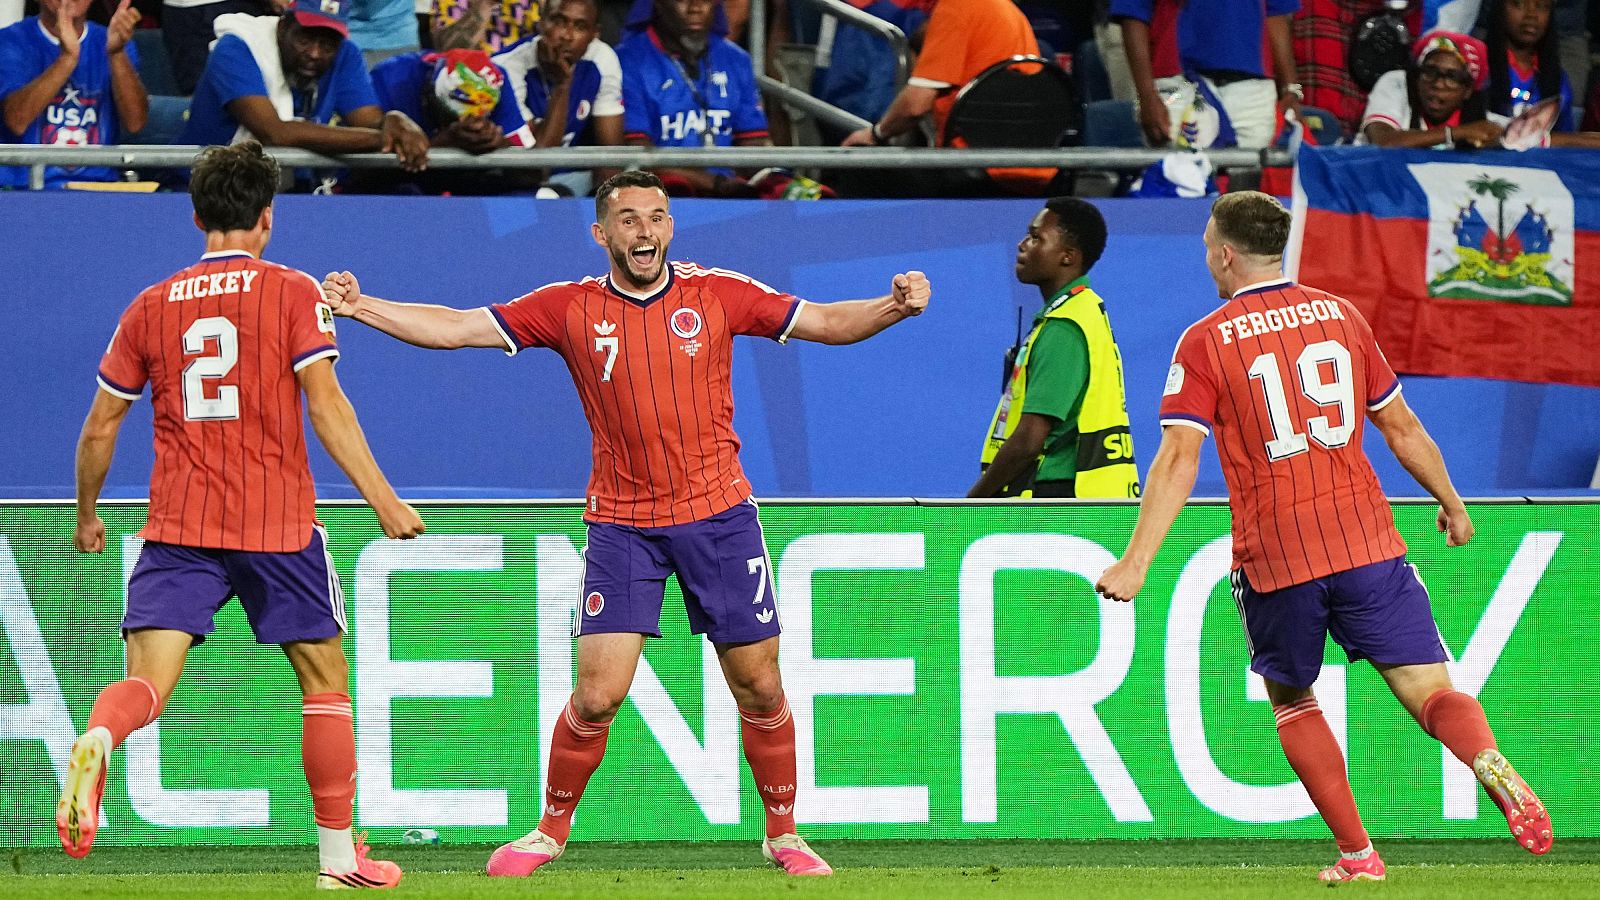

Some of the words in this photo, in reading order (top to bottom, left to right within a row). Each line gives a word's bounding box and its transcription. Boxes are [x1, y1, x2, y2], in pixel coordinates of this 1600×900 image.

[46, 104, 97, 127] USA
[168, 269, 259, 303] HICKEY
[1217, 297, 1346, 346] FERGUSON
[181, 315, 241, 422] 2
[593, 336, 620, 383] 7
[1248, 338, 1356, 463] 19
[1103, 433, 1133, 460] SU
[746, 555, 768, 605] 7
[354, 530, 1563, 827] ENERGY
[763, 783, 795, 795] ALBA
